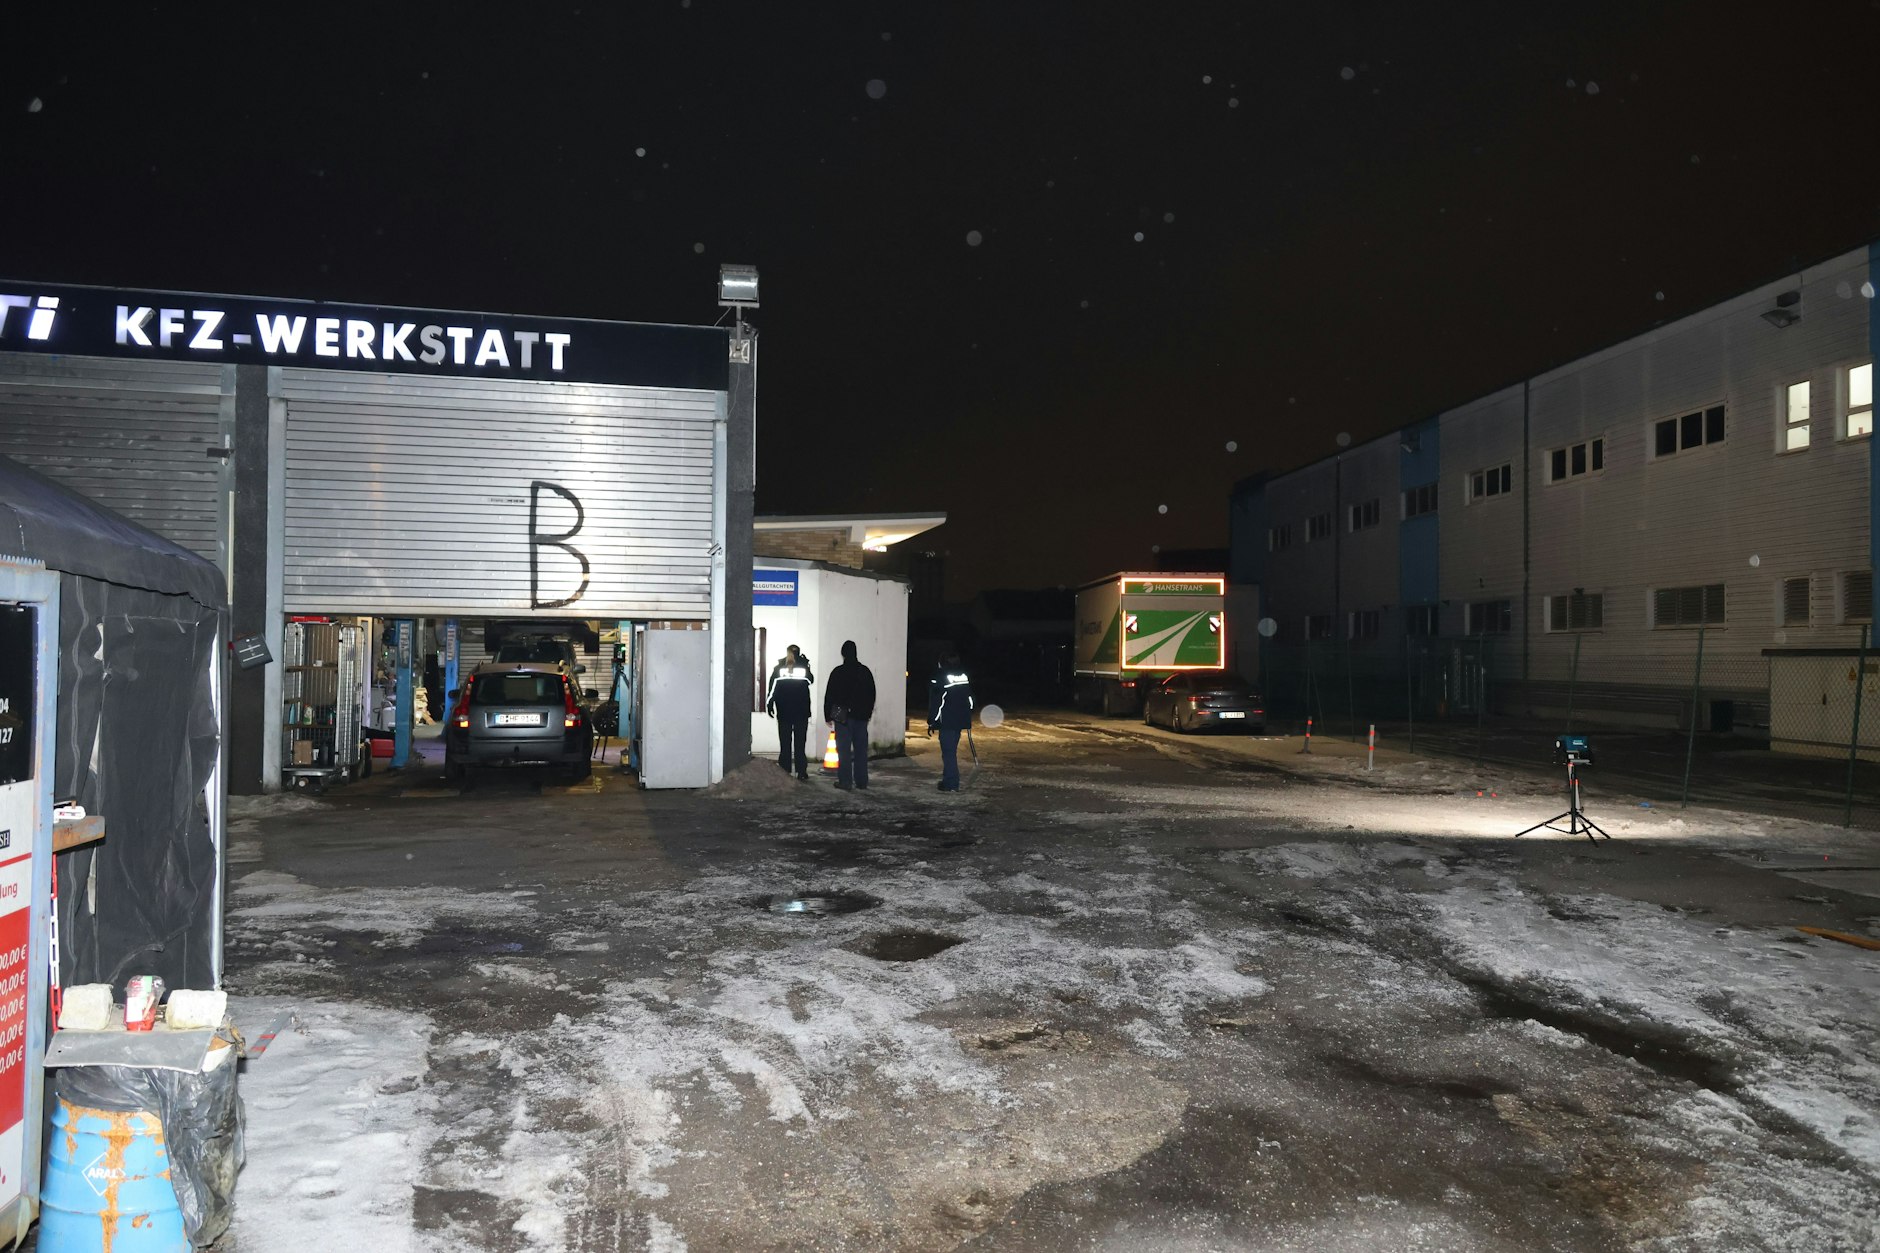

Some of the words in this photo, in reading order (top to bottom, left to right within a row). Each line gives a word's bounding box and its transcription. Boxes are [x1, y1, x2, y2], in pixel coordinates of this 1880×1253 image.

[115, 304, 572, 371] KFZ-WERKSTATT
[529, 481, 590, 610] B
[1154, 584, 1203, 592] HANSETRANS
